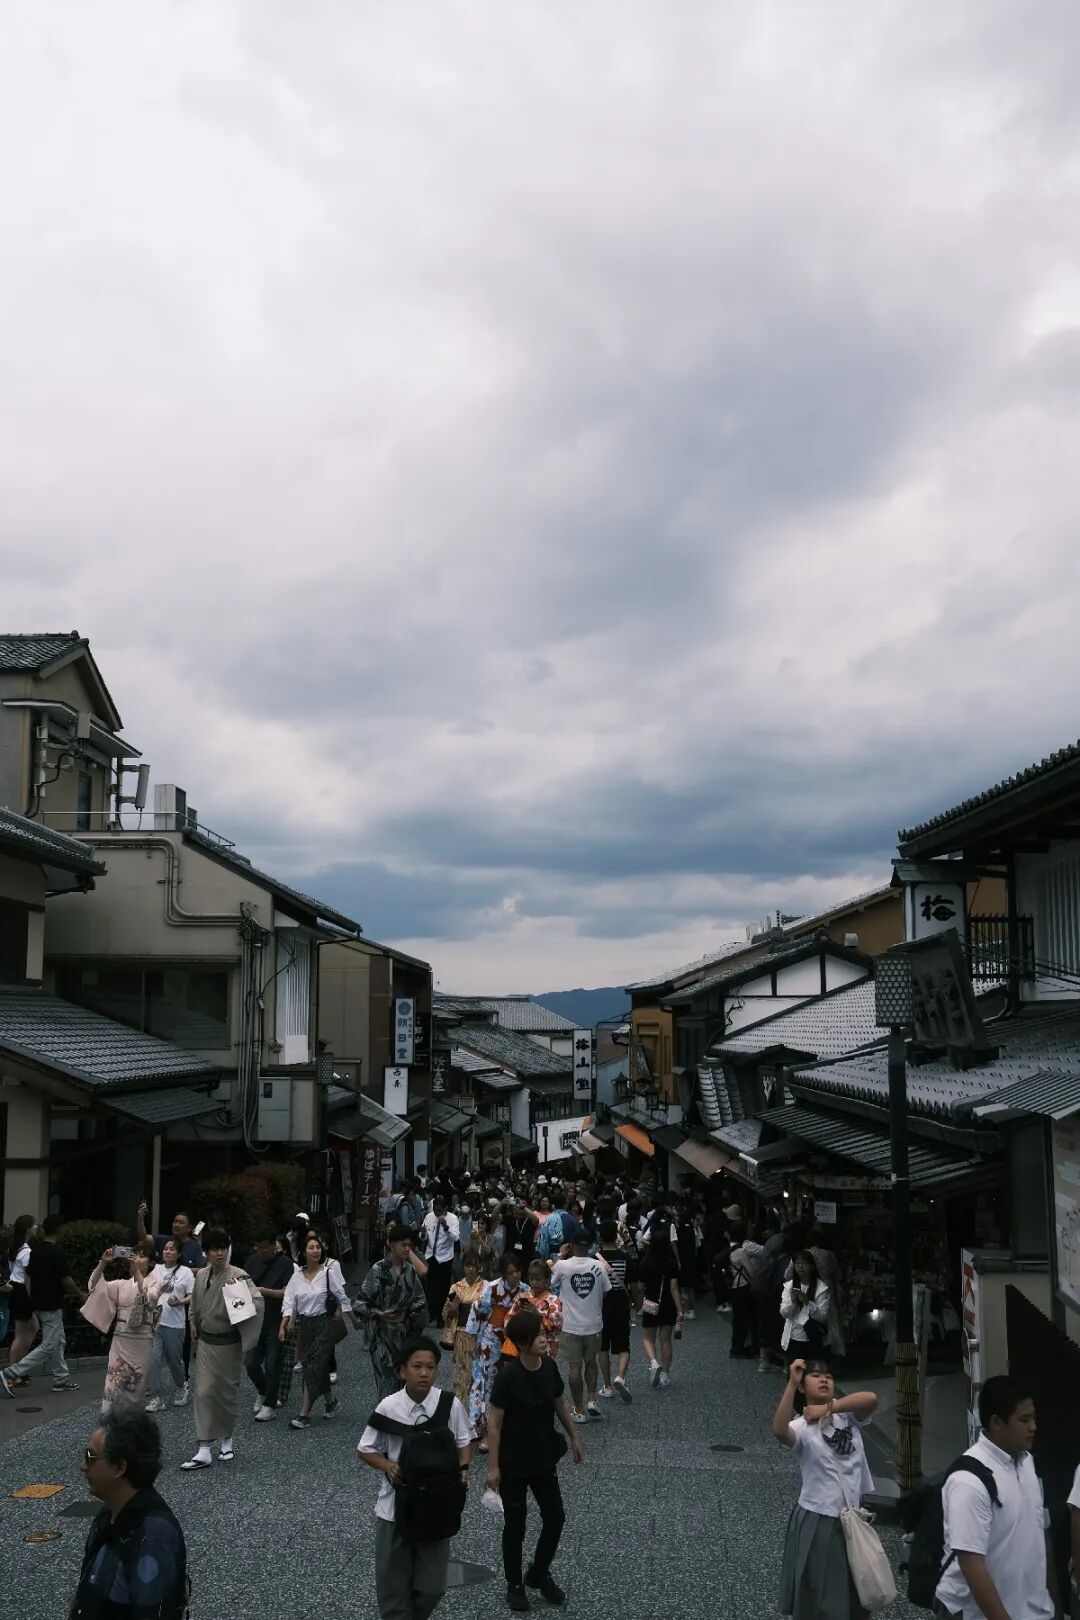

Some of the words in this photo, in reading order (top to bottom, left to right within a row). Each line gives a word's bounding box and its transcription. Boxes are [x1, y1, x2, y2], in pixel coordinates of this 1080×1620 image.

[360, 1148, 375, 1206] ゆばチーズ
